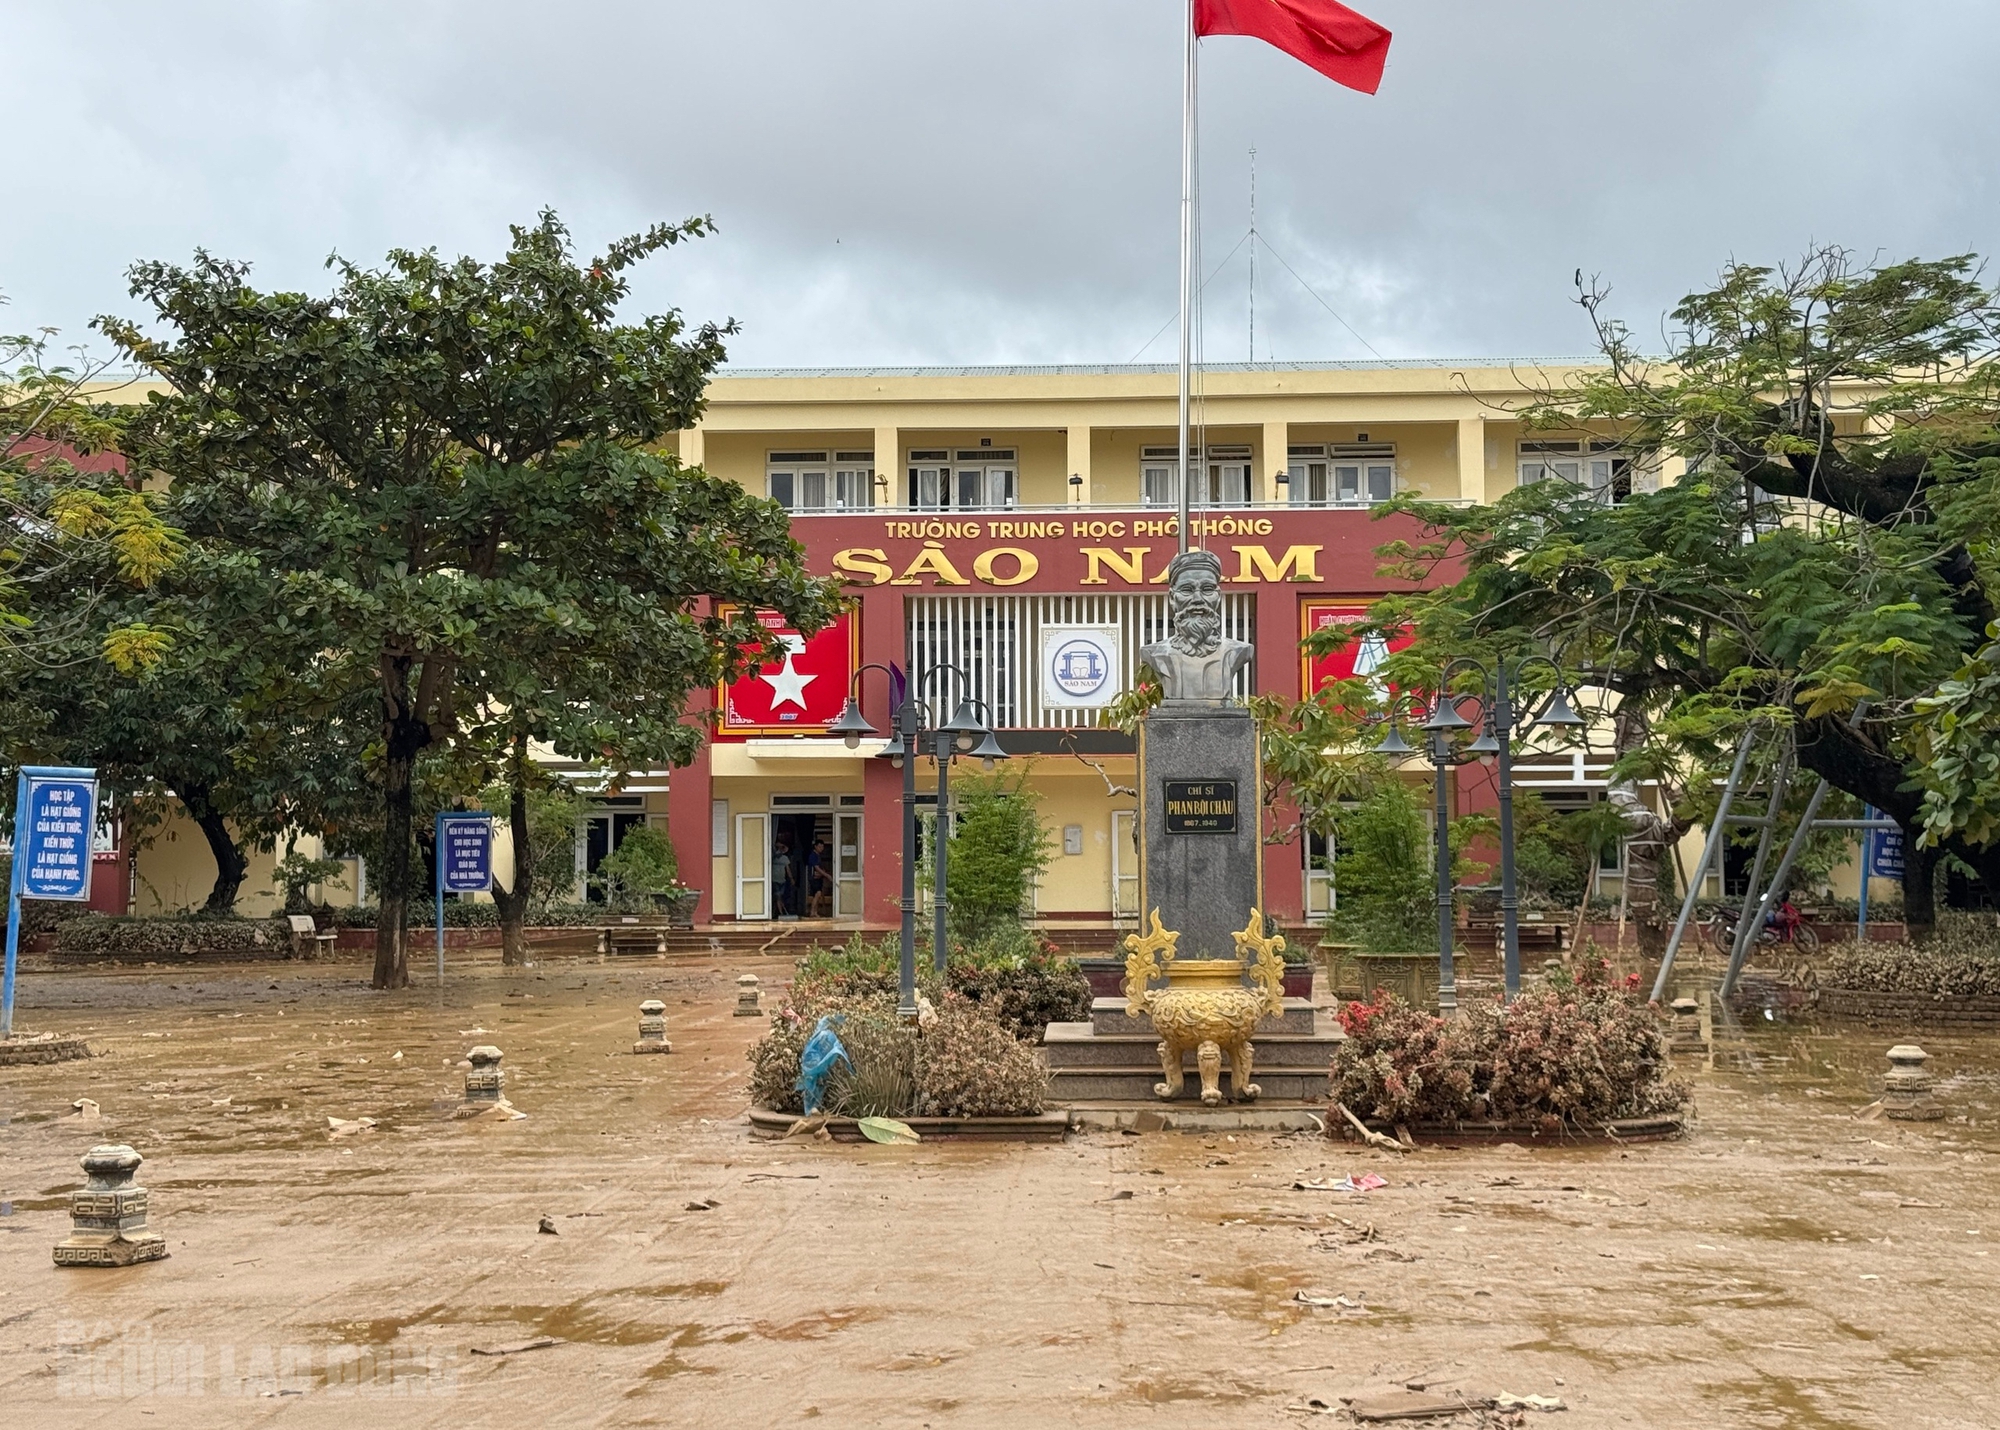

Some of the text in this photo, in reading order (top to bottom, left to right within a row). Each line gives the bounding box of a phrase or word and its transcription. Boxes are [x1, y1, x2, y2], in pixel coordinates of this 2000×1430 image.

[885, 517, 981, 538] TRƯỜNG
[987, 521, 1065, 539] TRUNG
[1072, 520, 1126, 542] HỌC
[1189, 515, 1273, 535] THÔNG
[830, 540, 1039, 586] SÀO
[50, 789, 75, 803] HỌC TẬP
[1188, 785, 1202, 795] CHÍ
[41, 803, 81, 819] LÀ HẠT GIỐNG
[1168, 799, 1234, 816] PHAN BỘI CHÂU
[37, 818, 50, 832] CỦA
[51, 818, 65, 833] KIẾN
[43, 834, 75, 849] KIẾN THỨC
[37, 850, 78, 867] LÀ HẠT GIỐNG
[31, 865, 44, 879] CỦA
[45, 869, 61, 881] HẠNH
